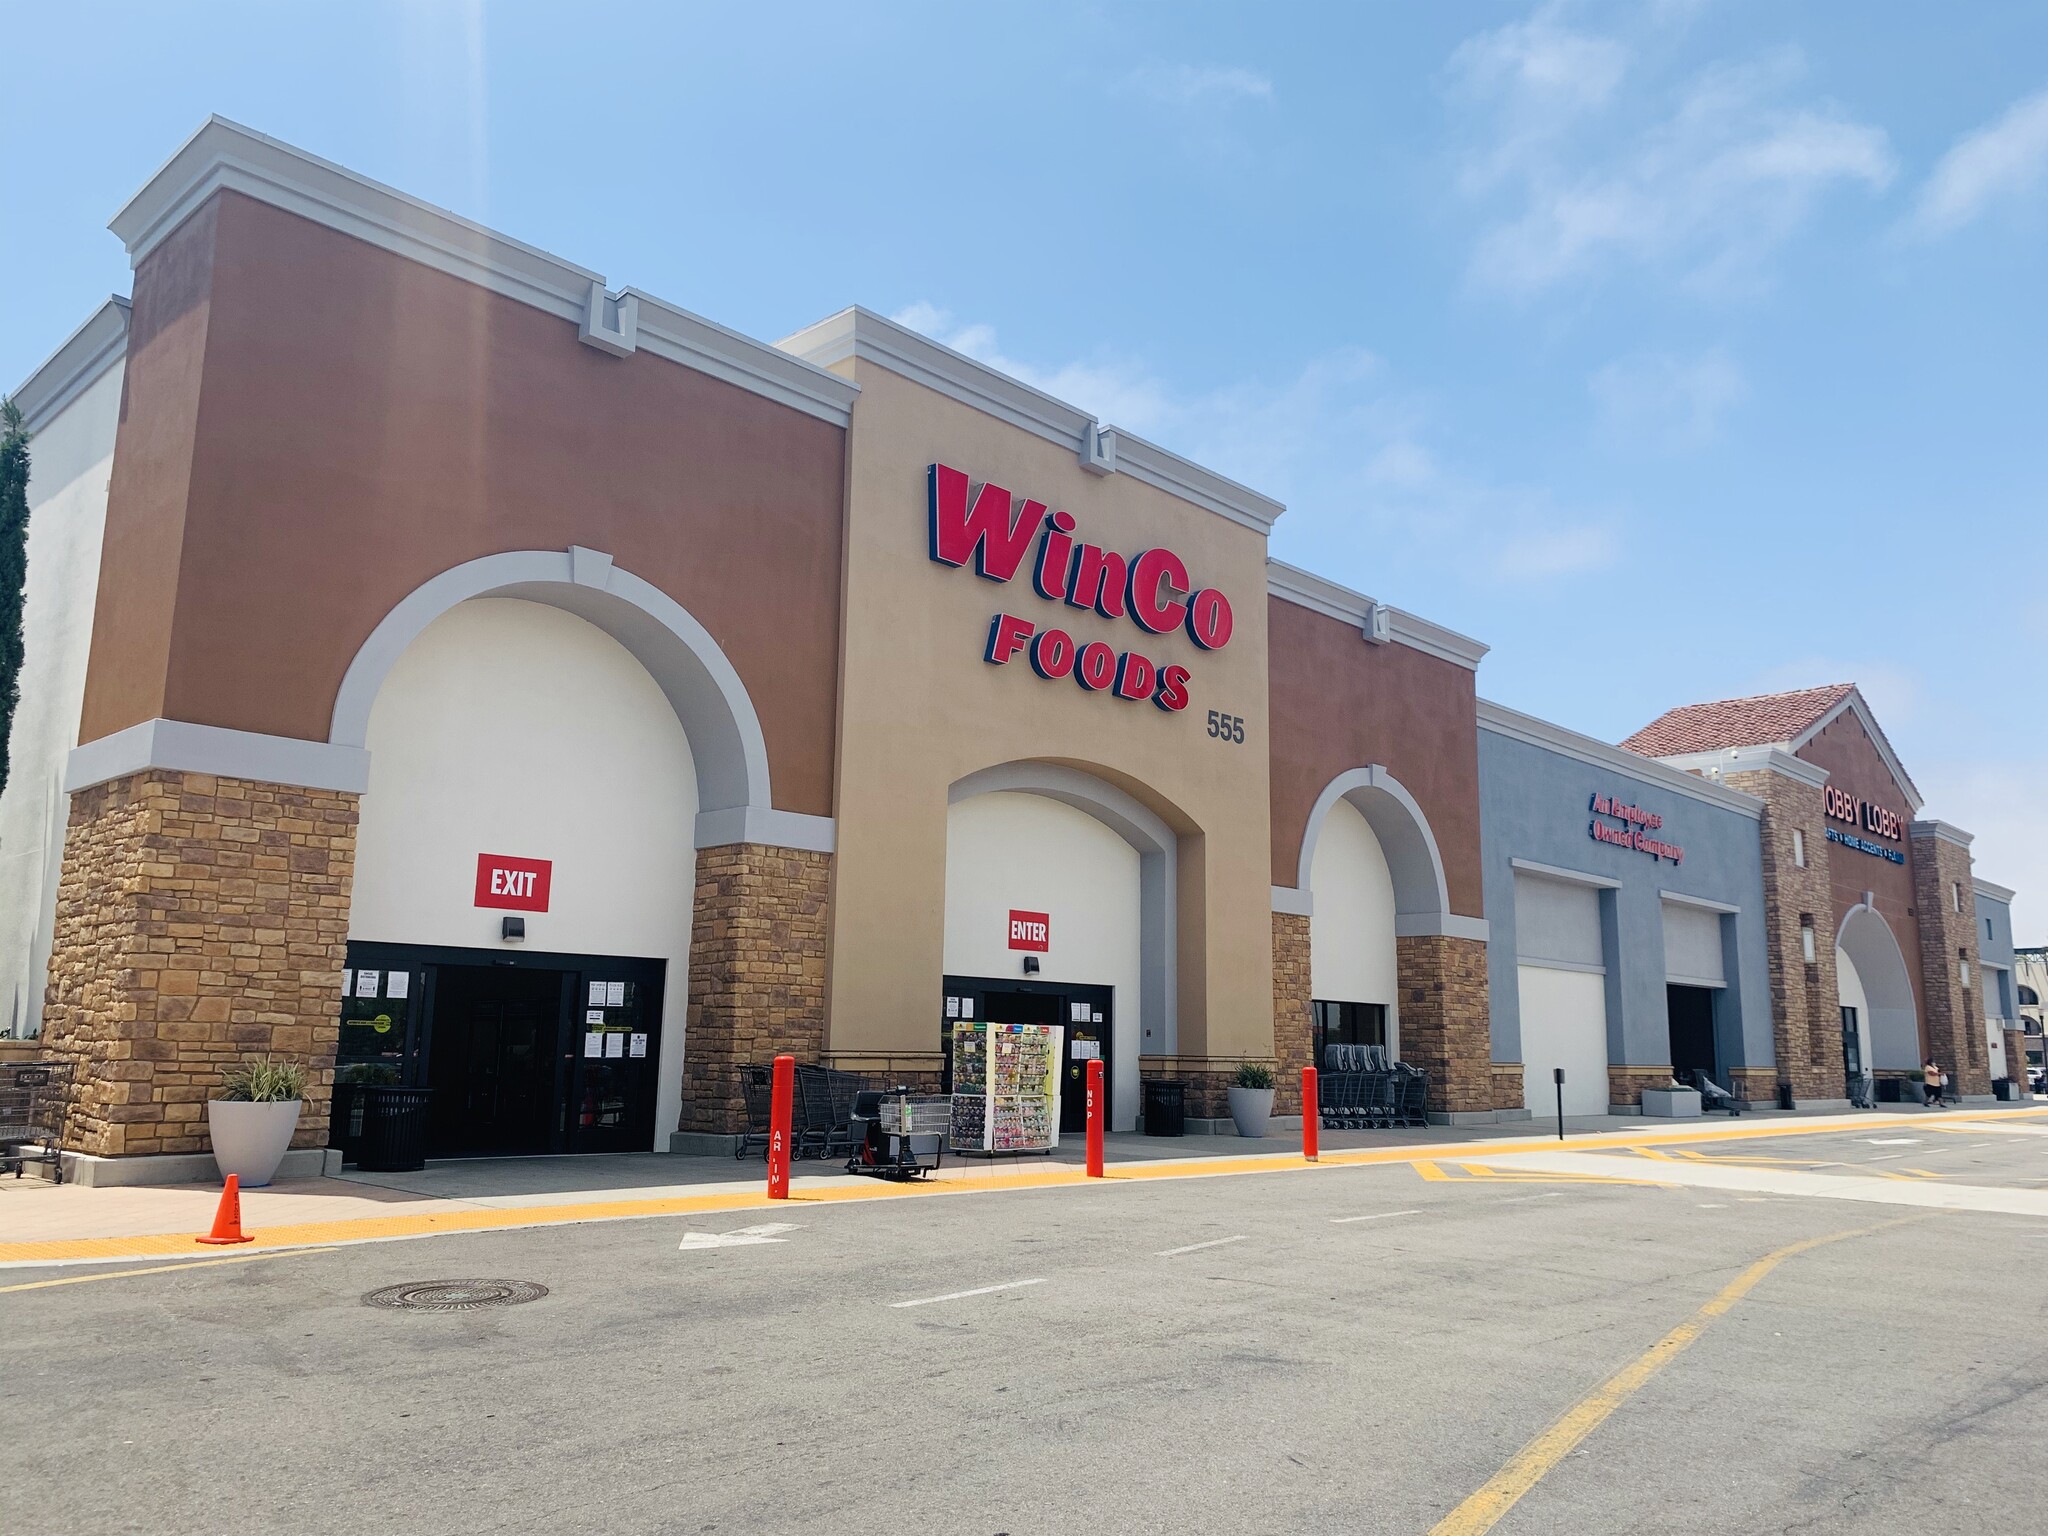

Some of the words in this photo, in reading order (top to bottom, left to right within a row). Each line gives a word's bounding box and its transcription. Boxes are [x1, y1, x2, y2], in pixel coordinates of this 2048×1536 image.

[928, 462, 1234, 651] WinCo
[984, 613, 1191, 712] FOODS
[1207, 710, 1245, 744] 555
[1589, 792, 1611, 815] An
[1611, 797, 1663, 830] Employee
[1823, 785, 1860, 825] OBBY
[1863, 802, 1903, 841] LOBBY
[1588, 820, 1634, 849] Owned
[1633, 831, 1685, 866] Company
[490, 868, 537, 897] EXIT
[1011, 920, 1046, 942] ENTER
